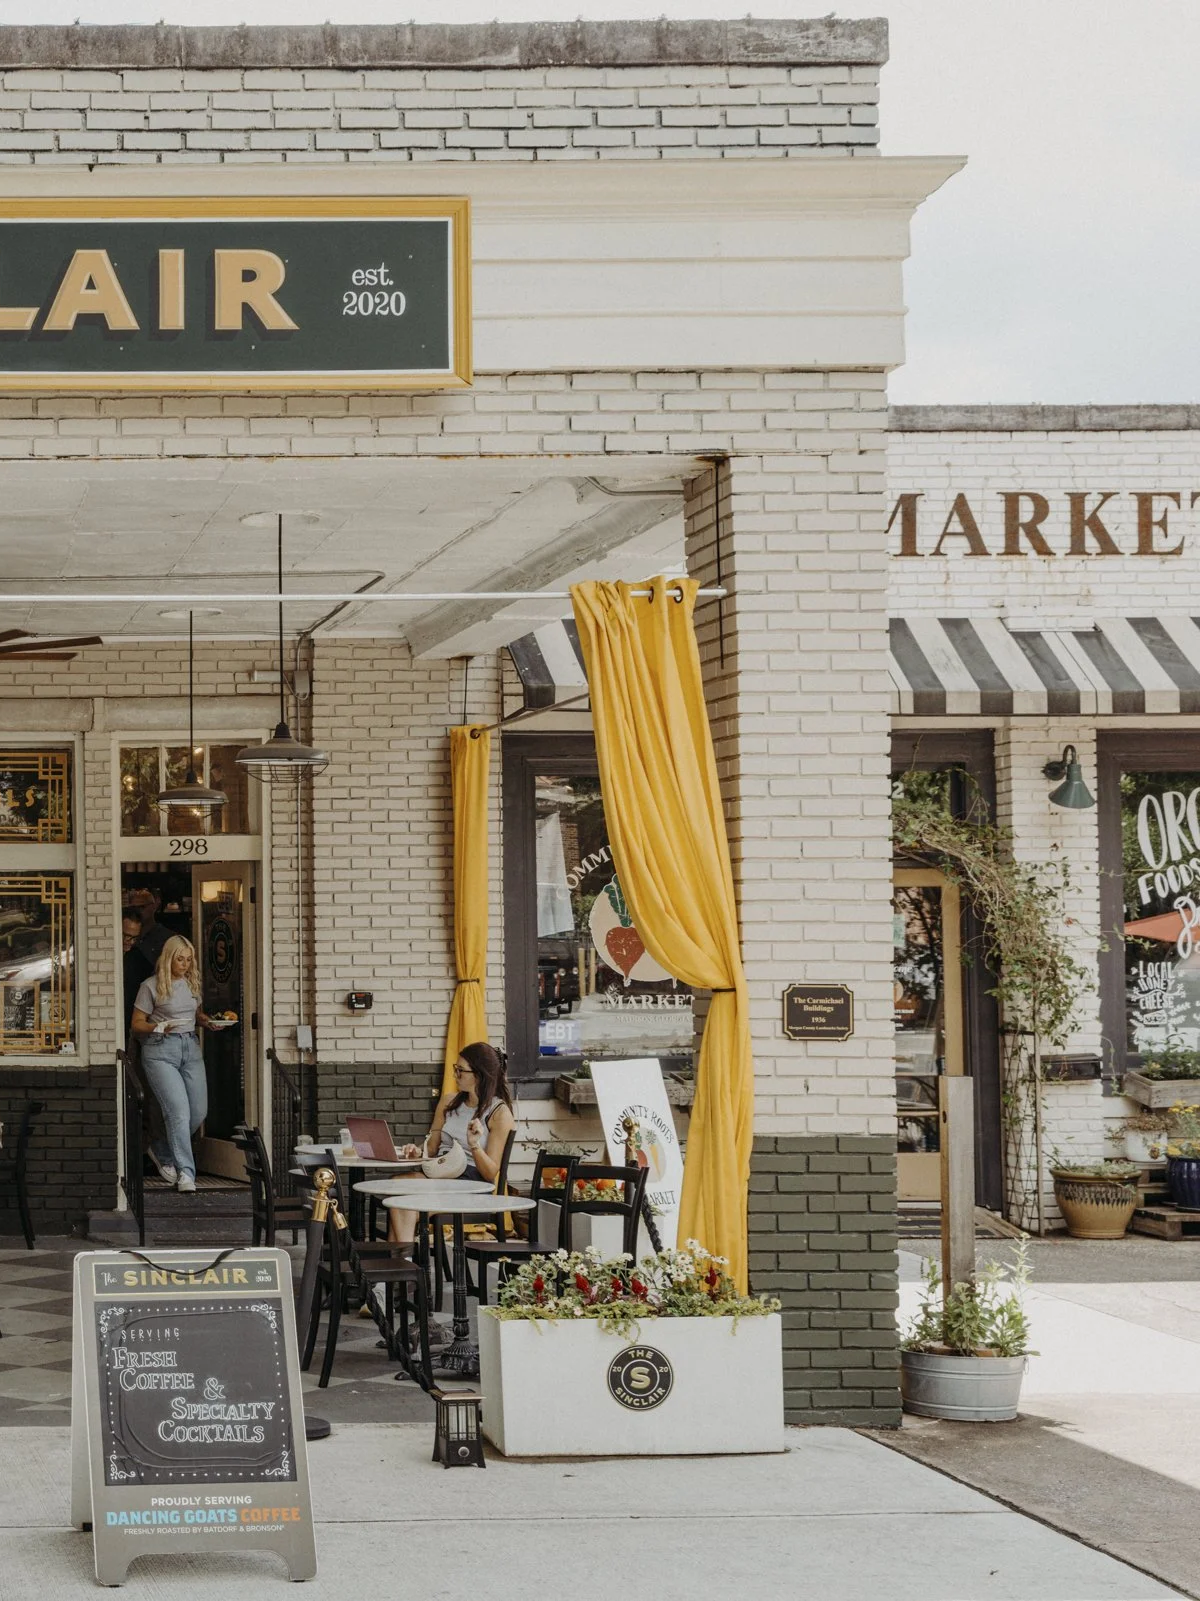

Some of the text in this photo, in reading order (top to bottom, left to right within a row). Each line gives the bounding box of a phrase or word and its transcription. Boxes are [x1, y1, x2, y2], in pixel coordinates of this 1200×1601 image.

[351, 261, 395, 287] est.
[342, 290, 407, 317] 2020
[169, 838, 209, 857] 298
[1139, 960, 1176, 979] LOCAL
[1137, 976, 1176, 991] HONEY
[1139, 991, 1175, 1010] CHEESE
[545, 1022, 575, 1041] EBT
[650, 1110, 673, 1144] ROOTS
[100, 1268, 249, 1287] The SINCLAIR
[255, 1274, 272, 1283] 2020
[121, 1327, 181, 1340] SERVING
[111, 1346, 178, 1370] FRESH
[628, 1350, 654, 1359] THE
[119, 1368, 196, 1392] COFFEE
[630, 1366, 650, 1389] S
[203, 1377, 226, 1401] &
[615, 1387, 666, 1406] SINCLAIR
[171, 1396, 276, 1421] SPECIALTY
[158, 1419, 265, 1444] COCKTAILS
[151, 1495, 253, 1507] PROUDLY SERVING
[106, 1506, 301, 1526] DANCING GOATS COFFEE
[123, 1527, 156, 1536] FRESHLY
[156, 1526, 191, 1535] ROASTED
[191, 1526, 202, 1534] BY
[203, 1525, 238, 1534] BATDORF
